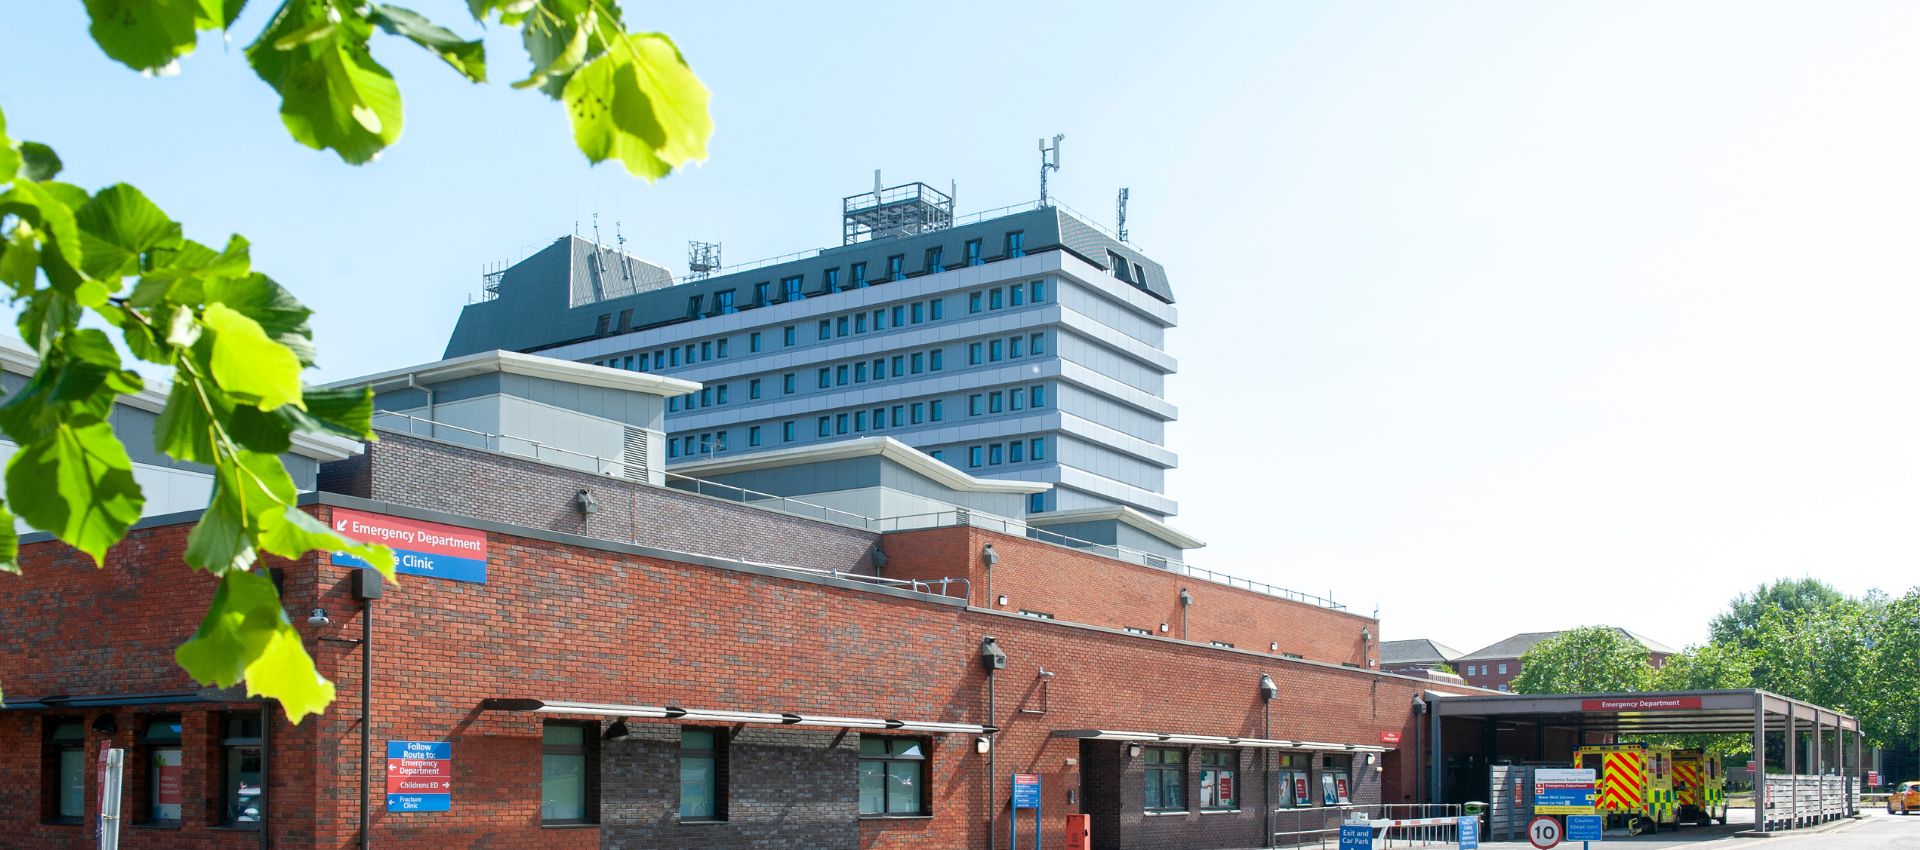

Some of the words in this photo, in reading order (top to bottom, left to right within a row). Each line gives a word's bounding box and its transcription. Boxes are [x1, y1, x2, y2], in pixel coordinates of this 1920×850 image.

[352, 521, 415, 543] Emergency
[417, 531, 481, 551] Department
[403, 554, 434, 570] Clinic
[1601, 701, 1639, 709] Emergency
[407, 742, 432, 751] Follow
[403, 751, 425, 759] Route
[426, 751, 436, 759] to:
[401, 759, 438, 769] Emergency
[399, 767, 440, 776] Department
[400, 781, 429, 789] Childrens
[1342, 829, 1356, 837] Exit
[1356, 829, 1369, 837] and
[1534, 825, 1555, 840] 10
[1342, 837, 1355, 845] Car
[1355, 837, 1369, 845] Park
